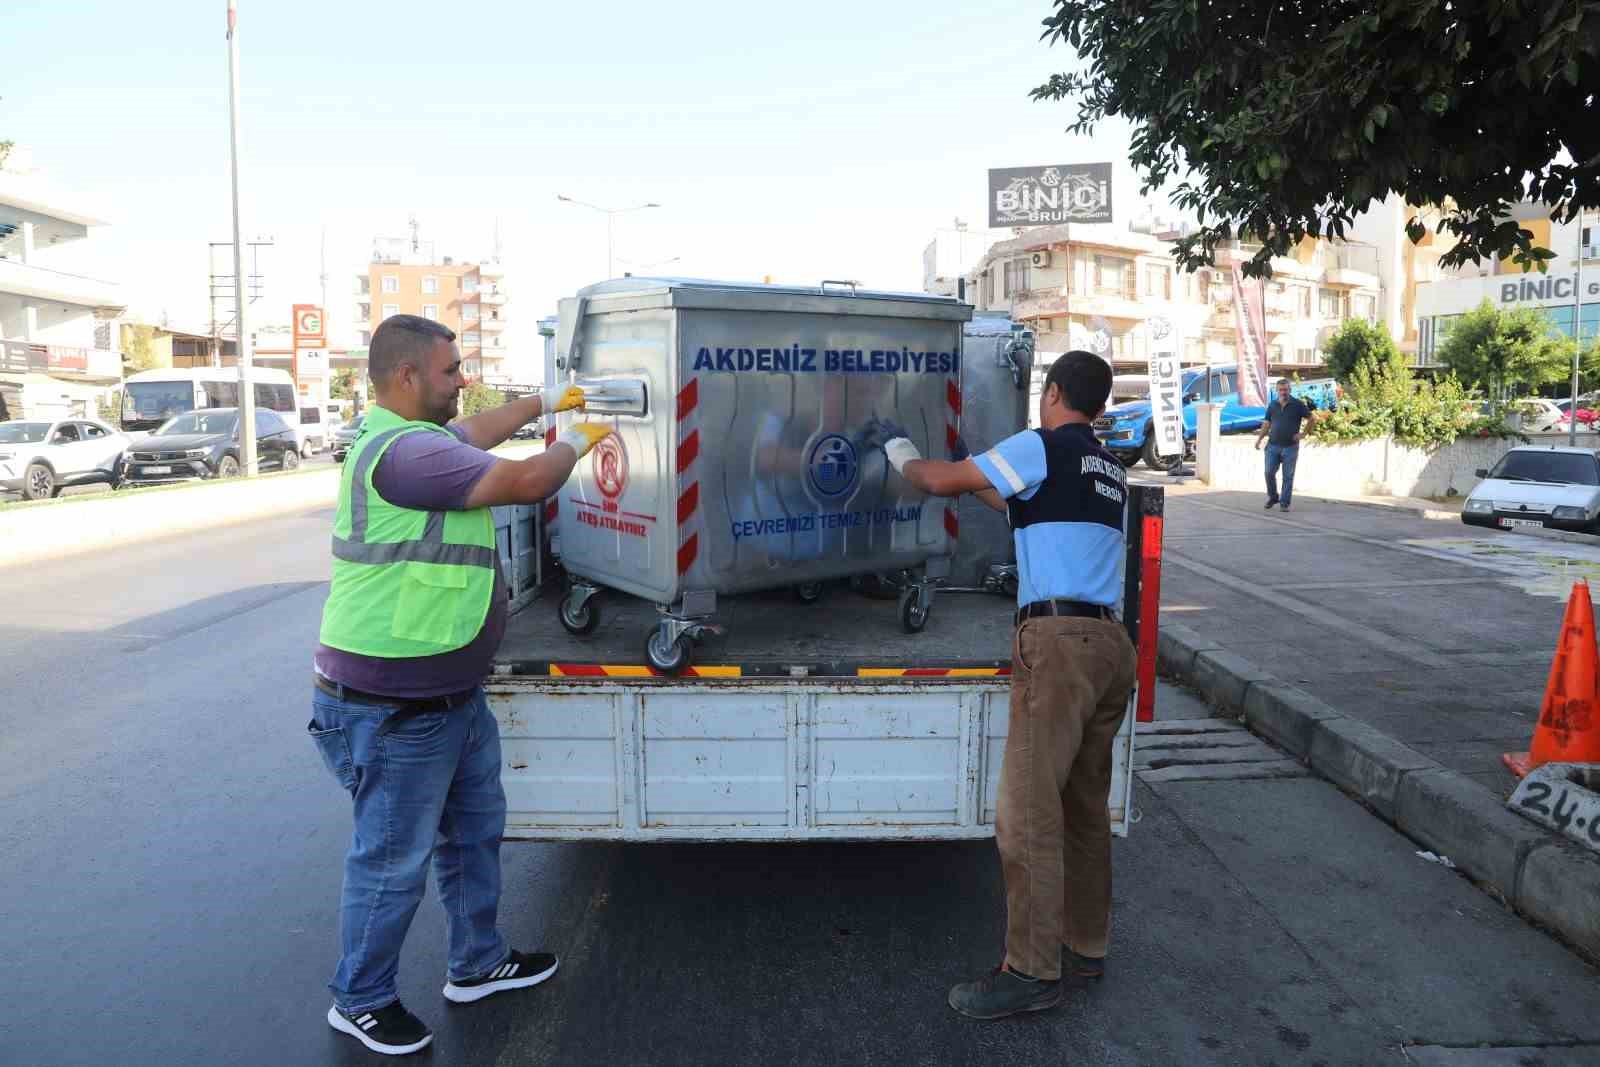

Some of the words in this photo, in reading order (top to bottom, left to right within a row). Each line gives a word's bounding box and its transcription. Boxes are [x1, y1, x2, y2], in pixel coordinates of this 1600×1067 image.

[997, 180, 1107, 211] BİNİCİ
[1029, 211, 1071, 222] GRUP
[1501, 272, 1578, 303] BİNİCİ
[693, 344, 816, 372] AKDENİZ
[824, 347, 959, 373] BELEDİYESİ
